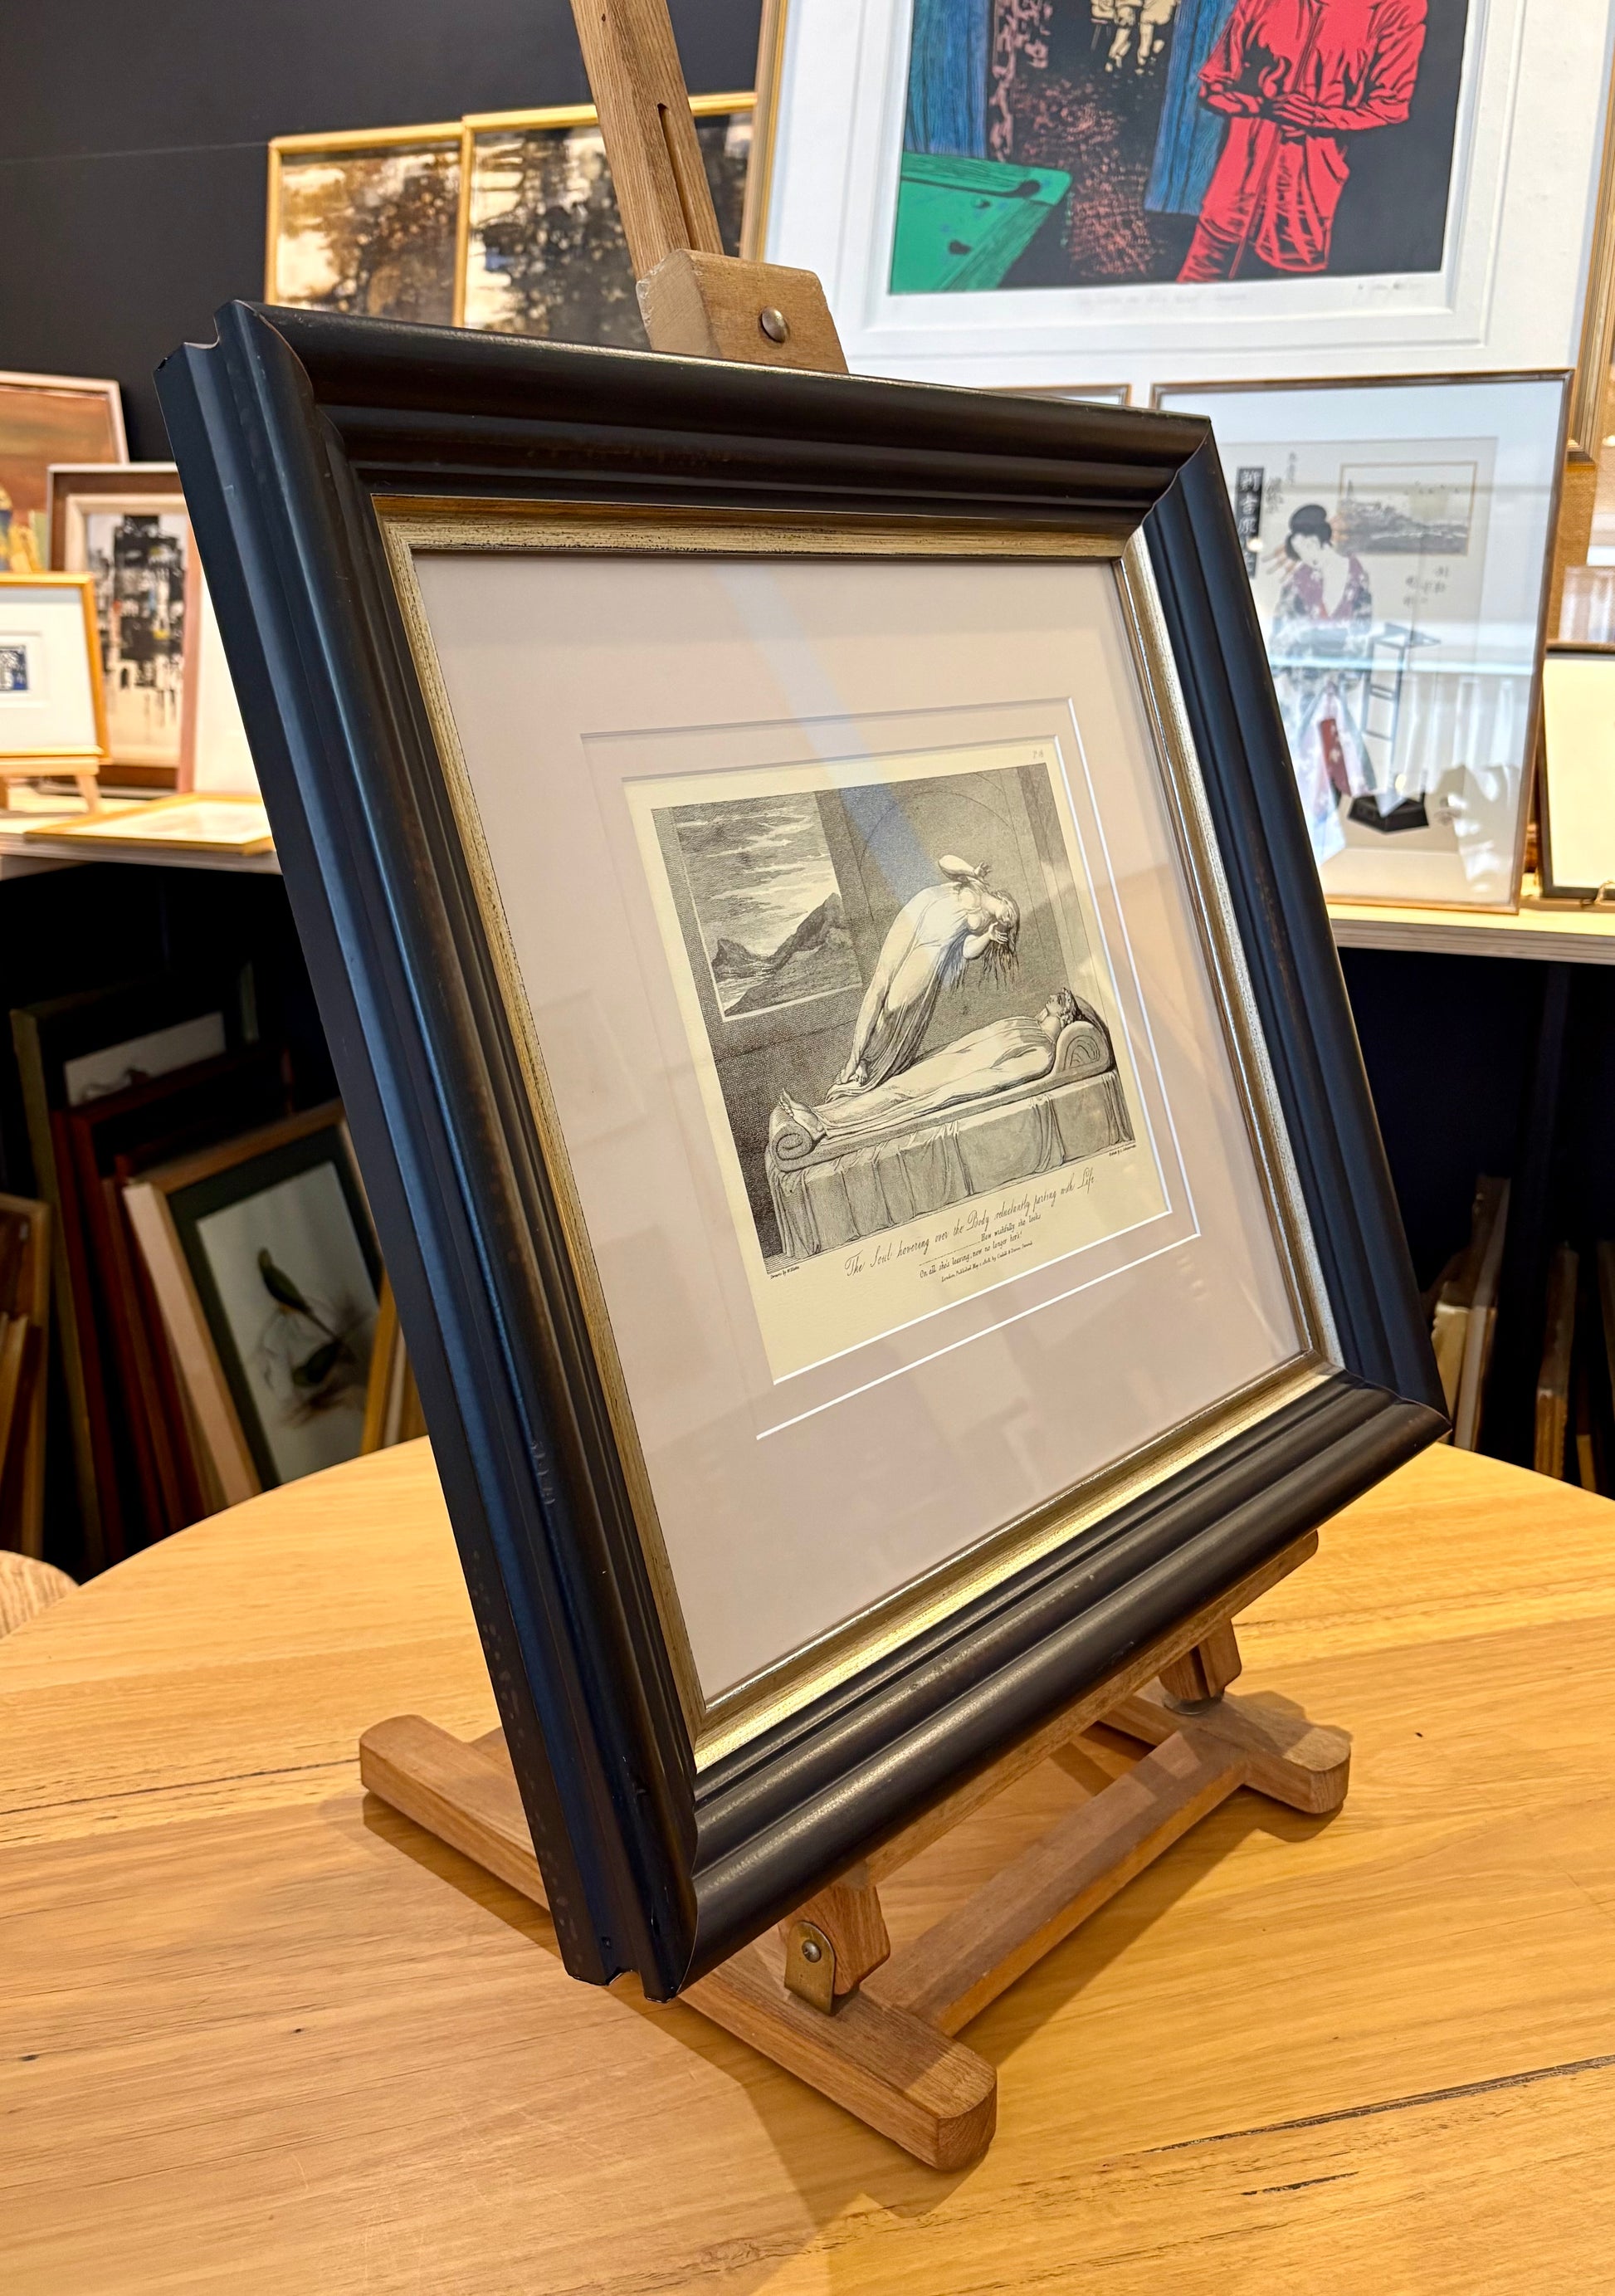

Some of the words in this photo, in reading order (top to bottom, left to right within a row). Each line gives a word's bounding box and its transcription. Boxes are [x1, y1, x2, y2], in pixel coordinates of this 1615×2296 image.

[844, 1249, 866, 1276] The
[870, 1243, 892, 1268] Soul
[897, 1238, 929, 1258] hovering
[934, 1231, 949, 1243] over
[953, 1219, 965, 1235] the
[966, 1209, 989, 1232] Body
[994, 1194, 1030, 1220] reluctantly
[1032, 1190, 1056, 1213] parting
[1061, 1172, 1075, 1194] with
[1077, 1167, 1095, 1194] Life
[993, 1238, 1008, 1250] longer
